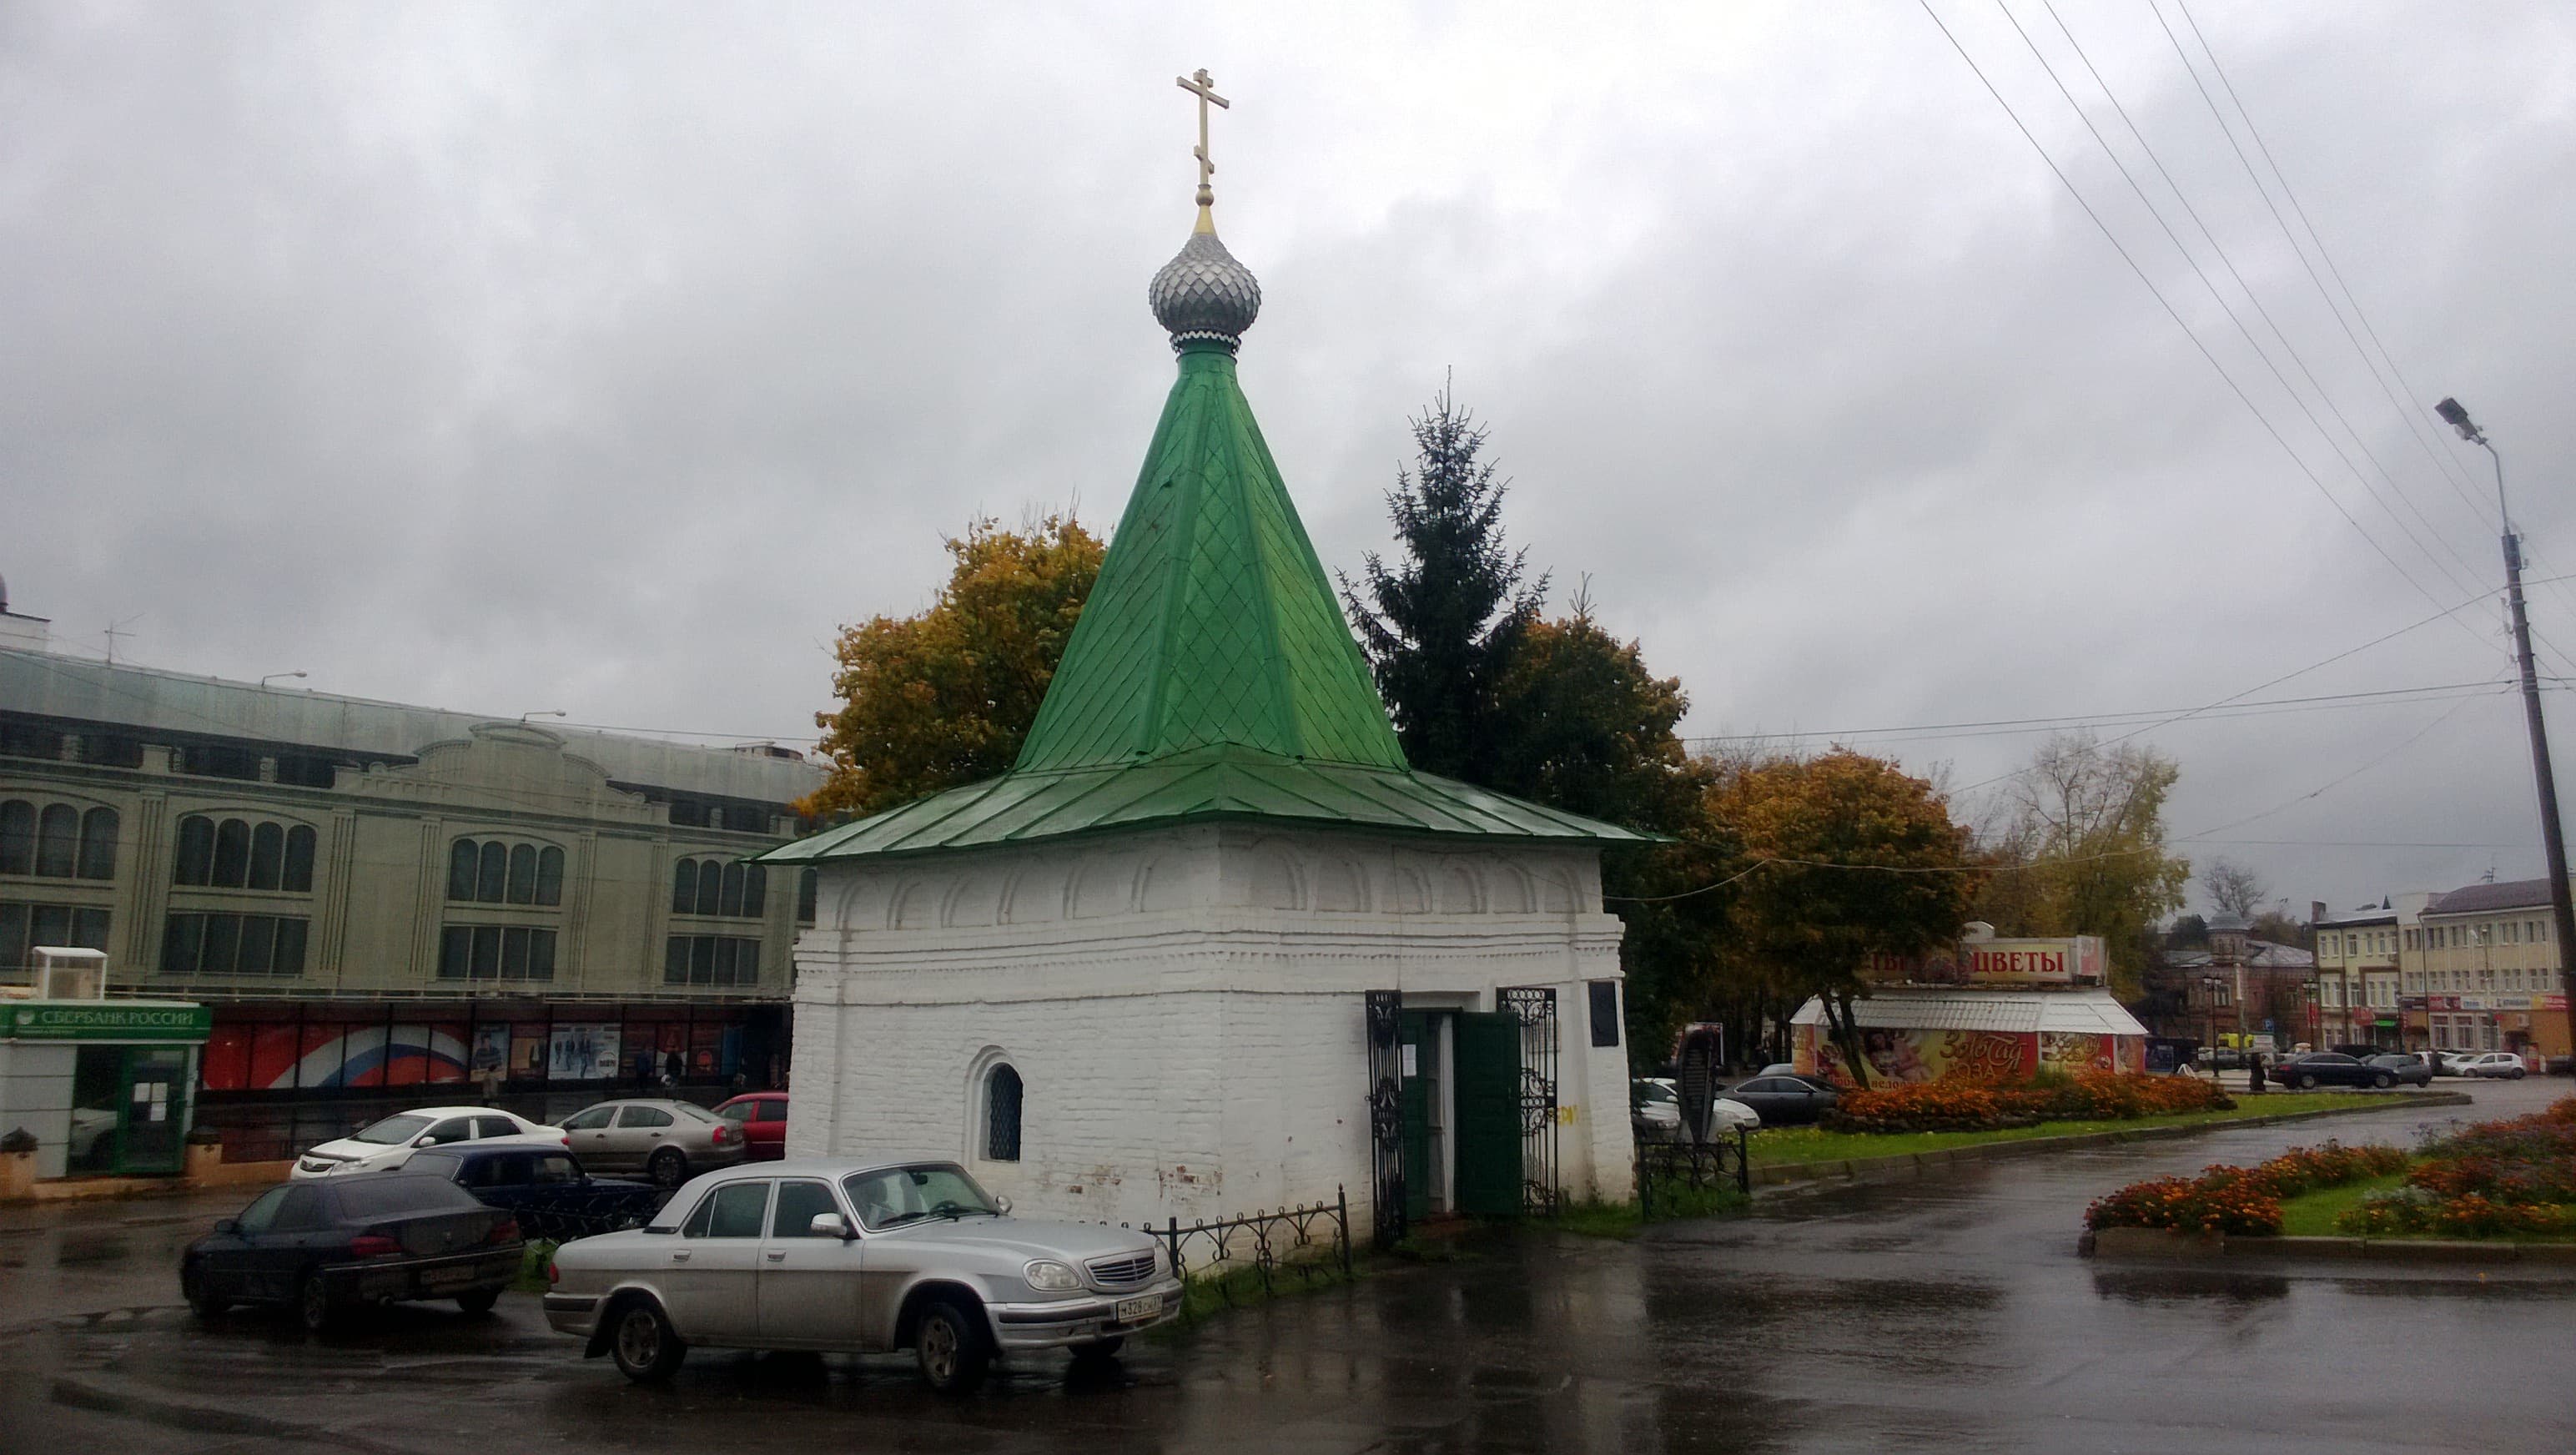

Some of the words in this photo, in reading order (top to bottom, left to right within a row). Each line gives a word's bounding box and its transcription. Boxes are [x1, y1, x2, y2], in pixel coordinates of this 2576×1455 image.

[1973, 951, 2065, 974] ЦВЕТЫ
[41, 1010, 126, 1025] СБЕРБАНК
[128, 1011, 194, 1025] РОССИИ
[1947, 1059, 1996, 1080] РОЗА
